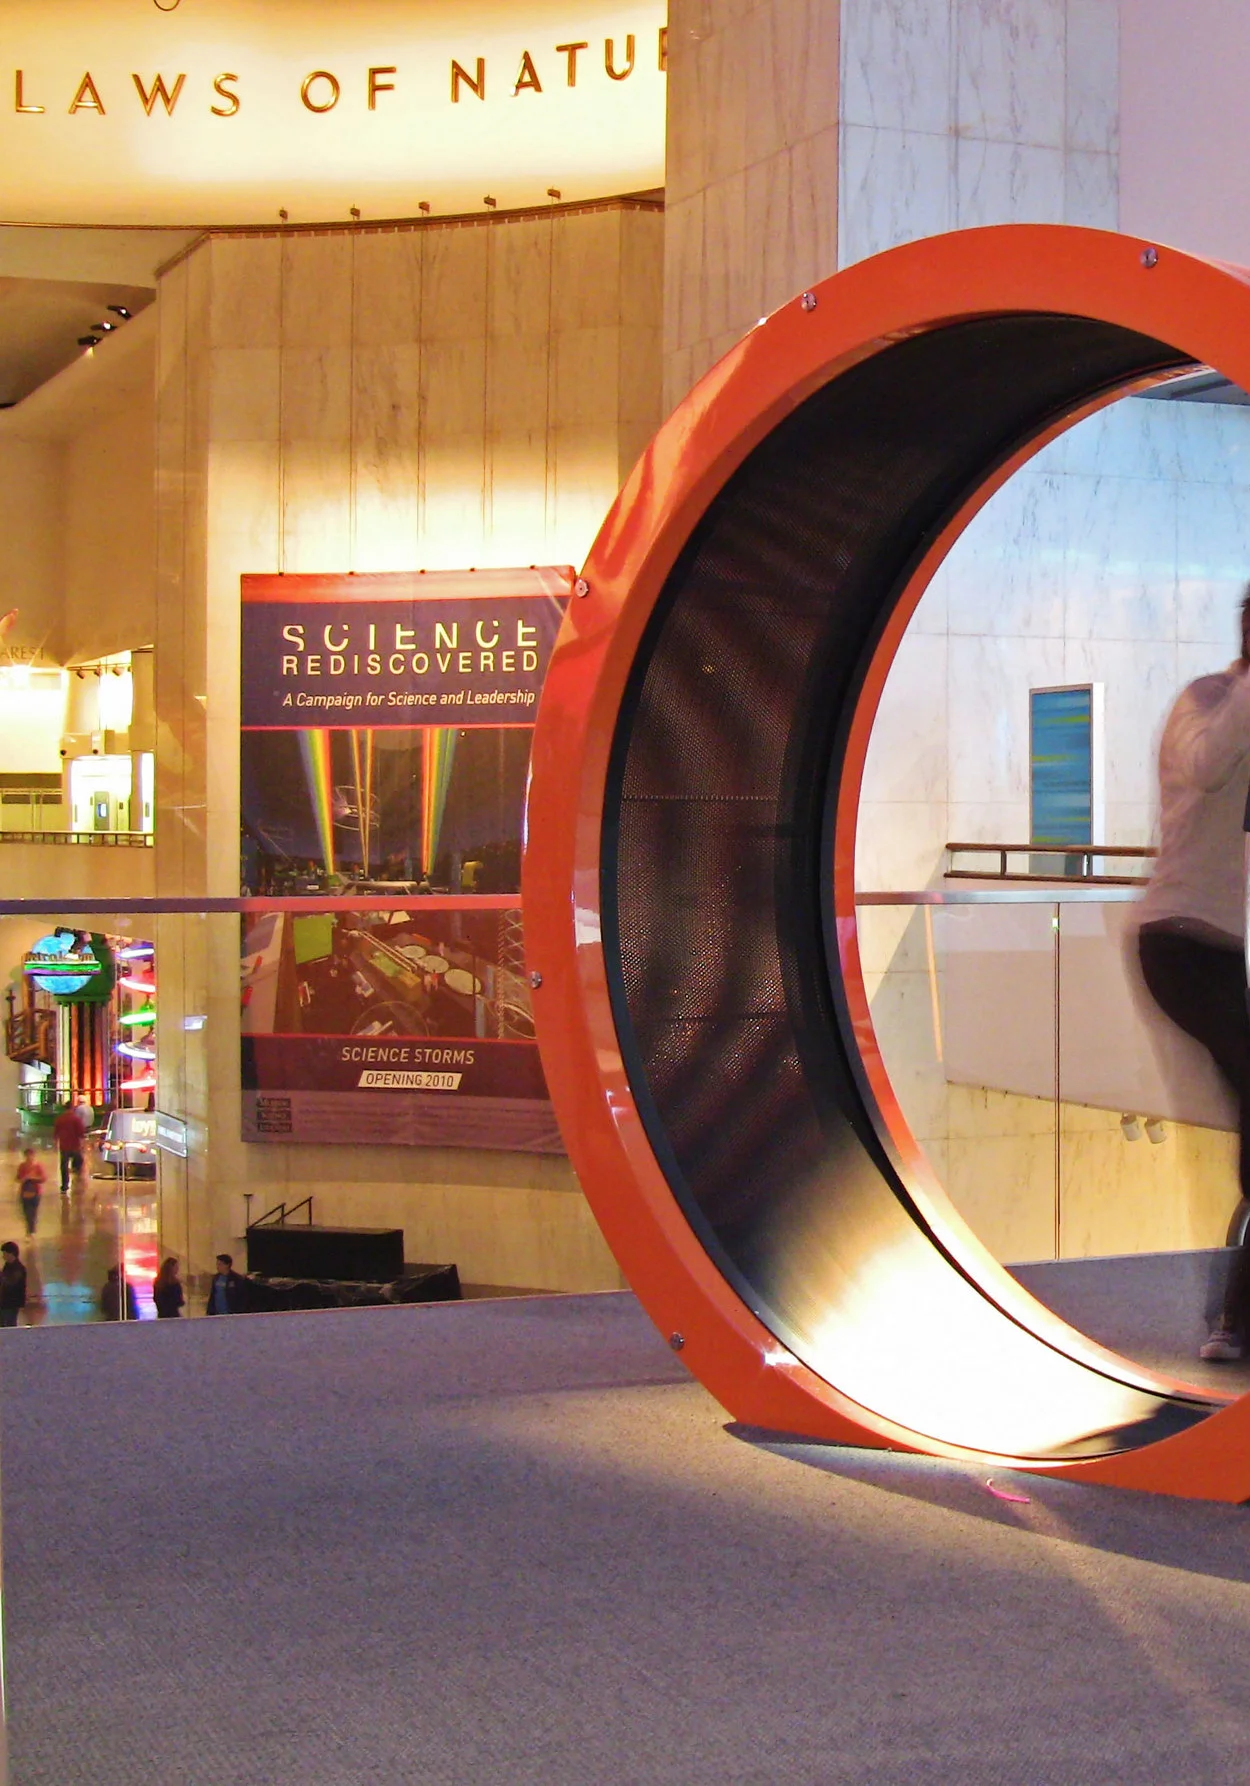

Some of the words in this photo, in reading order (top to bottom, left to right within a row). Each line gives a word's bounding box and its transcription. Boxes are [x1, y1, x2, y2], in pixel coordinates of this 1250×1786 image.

[15, 69, 240, 117] LAWS
[300, 66, 396, 114] OF
[282, 619, 538, 652] SCIENCE
[282, 650, 538, 676] REDISCOVERED
[282, 692, 293, 707] A
[296, 692, 362, 710] Campaign
[365, 692, 385, 706] for
[387, 691, 437, 706] Science
[439, 690, 465, 705] and
[466, 689, 535, 707] Leadership
[341, 1046, 411, 1062] SCIENCE
[414, 1048, 475, 1065] STORMS
[365, 1072, 423, 1086] OPENING
[425, 1074, 455, 1088] 2010
